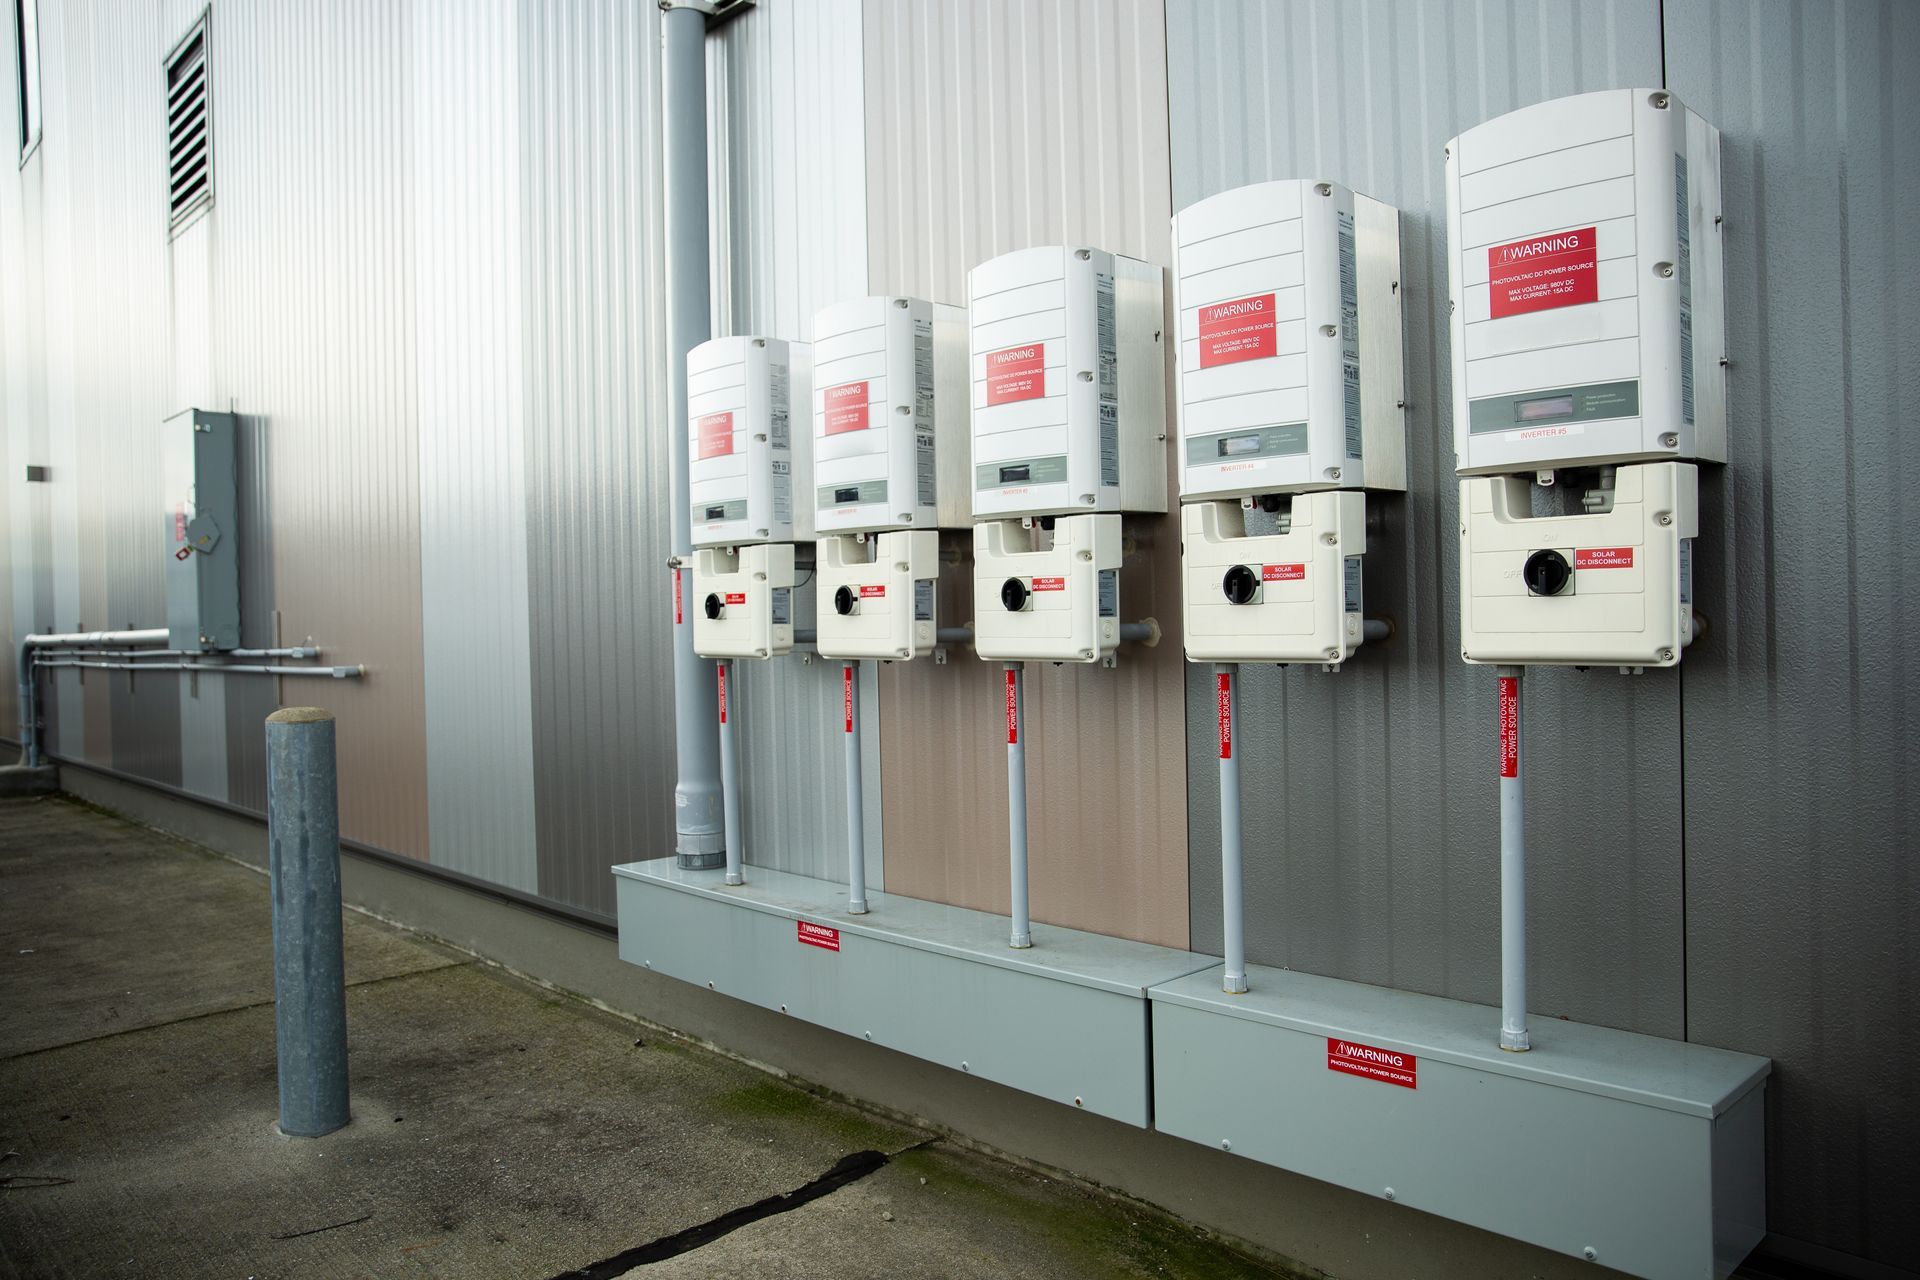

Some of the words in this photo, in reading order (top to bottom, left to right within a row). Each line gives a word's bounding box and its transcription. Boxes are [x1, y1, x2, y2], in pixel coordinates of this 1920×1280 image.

[1510, 236, 1578, 259] WARNING
[1492, 273, 1534, 286] PHOTOVOLTAIC
[1544, 266, 1566, 276] POWER
[1567, 262, 1594, 272] SOURCE
[1508, 287, 1520, 296] MAX
[1510, 294, 1522, 302] MAX
[1213, 300, 1262, 318] WARNING
[998, 349, 1034, 363] WARNING
[1520, 429, 1557, 439] INVERTER
[806, 925, 833, 937] WARNING
[1347, 1046, 1402, 1066] WARNING
[1331, 1060, 1368, 1072] PHOTOVOLTAIC
[1370, 1068, 1389, 1076] POWER
[1390, 1073, 1413, 1082] SOURCE
